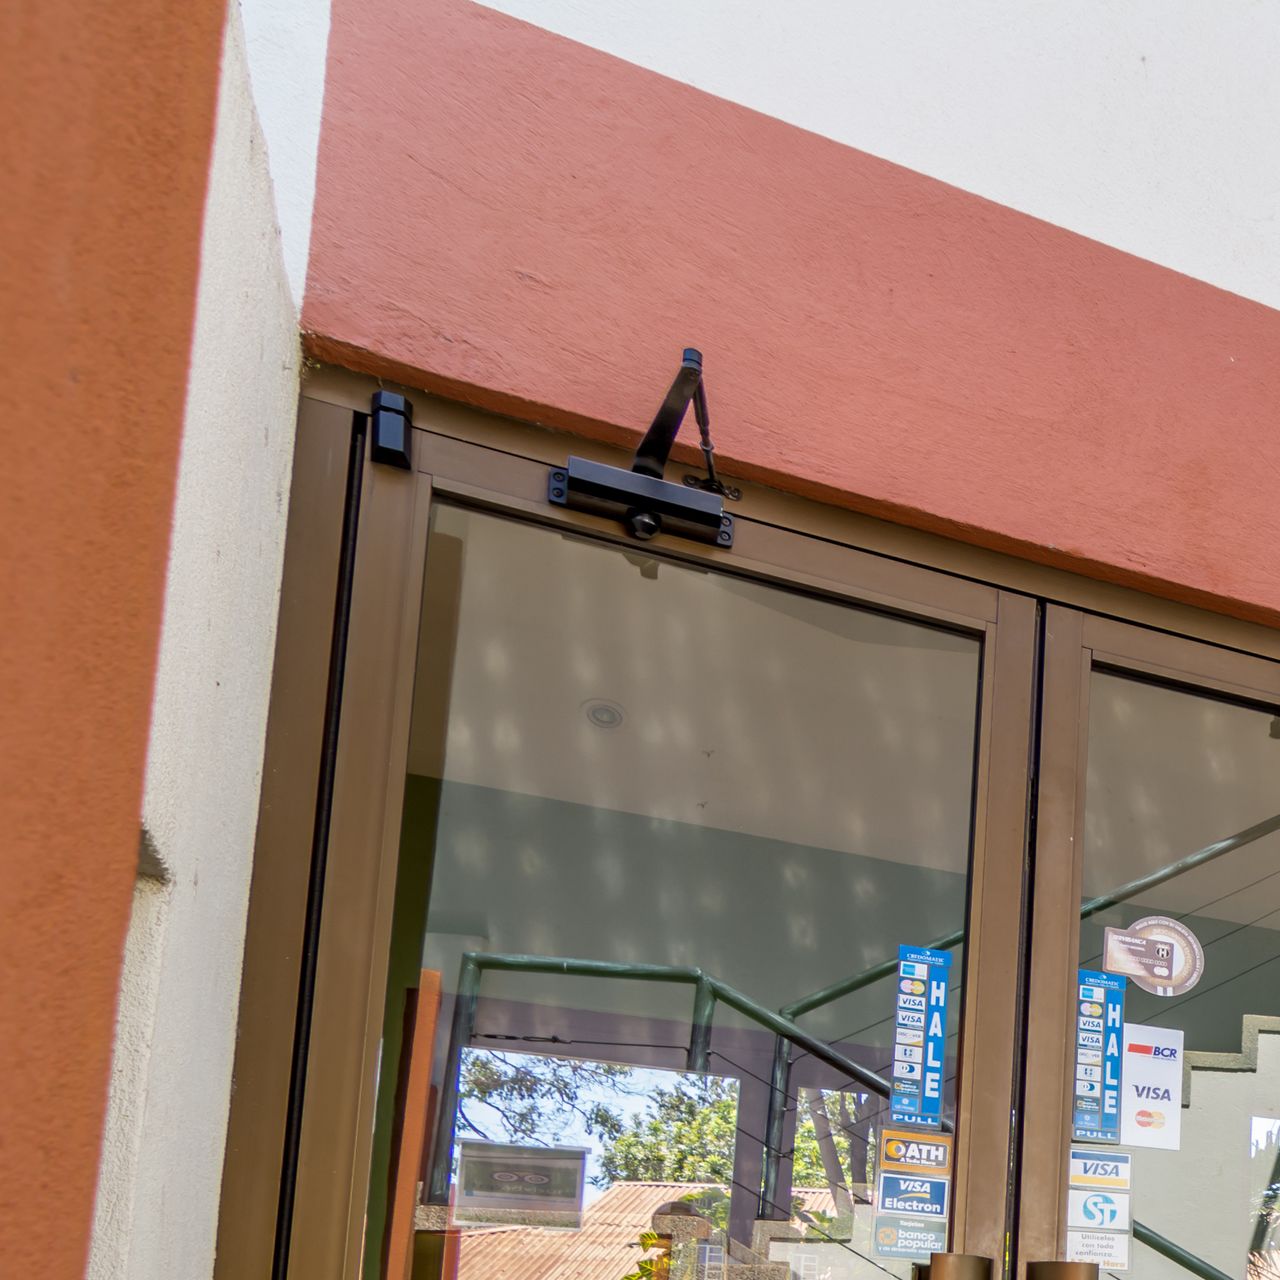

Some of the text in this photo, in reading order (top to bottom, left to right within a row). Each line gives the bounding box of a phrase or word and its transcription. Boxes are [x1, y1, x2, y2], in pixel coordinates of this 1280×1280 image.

[902, 998, 924, 1007] VISA
[900, 1014, 922, 1024] VISA
[1082, 1020, 1101, 1028] VISA
[925, 980, 946, 1098] HALE
[1081, 1035, 1101, 1044] VISA
[1104, 1003, 1121, 1114] HALE
[1153, 1046, 1177, 1059] BCR
[1132, 1084, 1171, 1101] VISA
[892, 1113, 938, 1125] PULL
[1076, 1129, 1116, 1139] PULL
[1082, 1162, 1120, 1177] VISA
[899, 1180, 931, 1193] VISA
[884, 1198, 941, 1212] Electron
[898, 1229, 936, 1241] banco
[897, 1238, 942, 1249] popular
